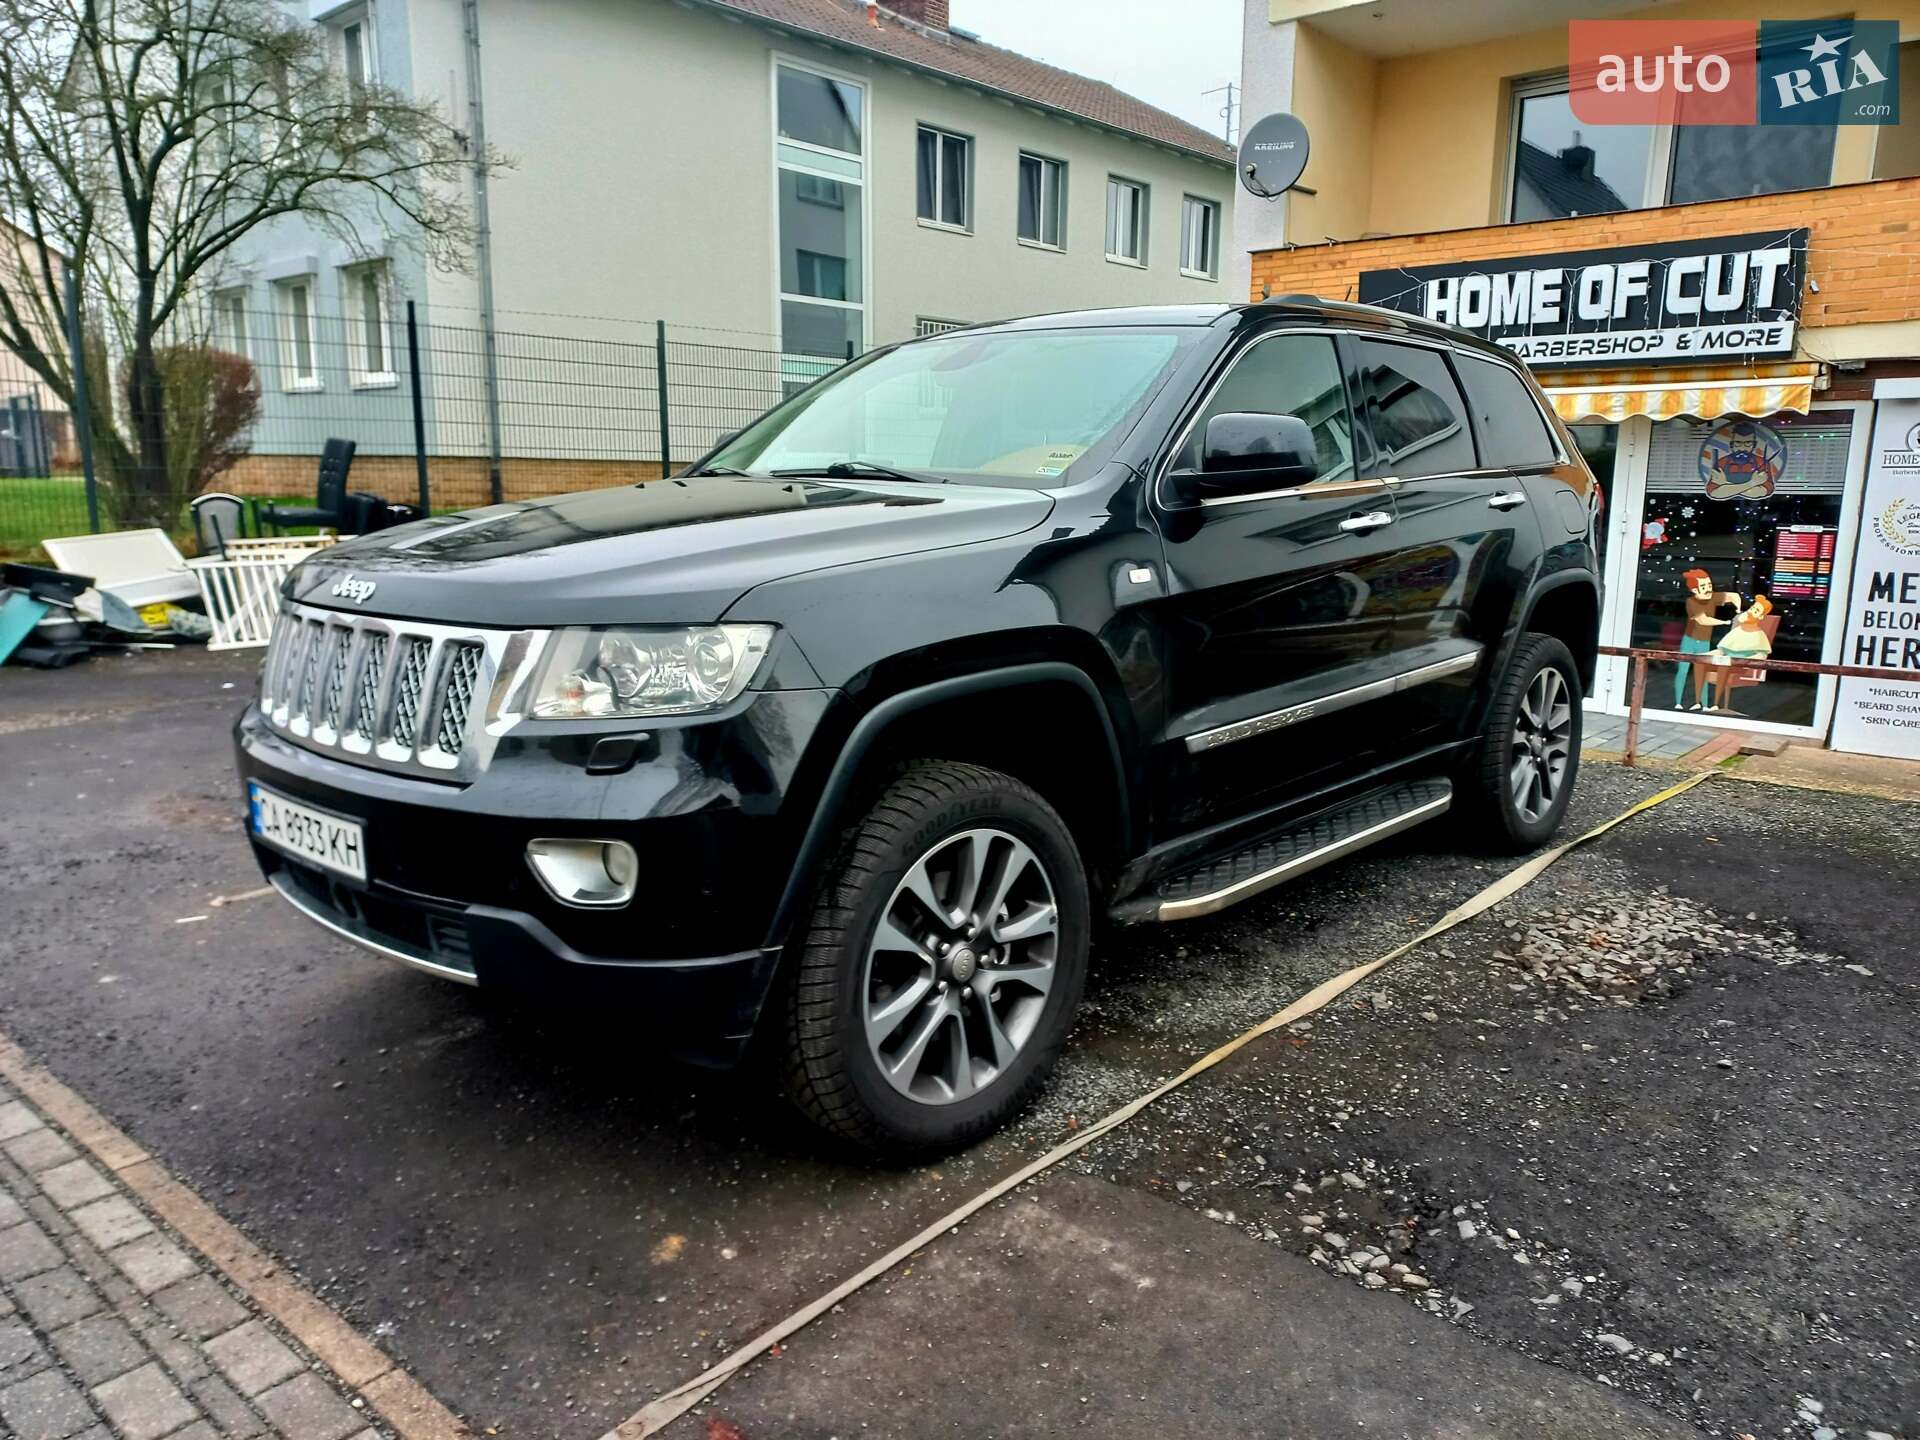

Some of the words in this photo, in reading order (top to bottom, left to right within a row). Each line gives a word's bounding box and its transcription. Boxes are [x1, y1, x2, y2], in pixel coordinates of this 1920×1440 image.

[1425, 267, 1564, 329] HOME
[1578, 262, 1651, 321] OF
[1667, 246, 1792, 315] CUT
[1676, 331, 1692, 350] &
[1701, 326, 1785, 350] MORE
[1883, 454, 1920, 465] HOME
[332, 574, 376, 605] Jeep
[1868, 571, 1920, 604] ME
[1854, 635, 1920, 669] HER
